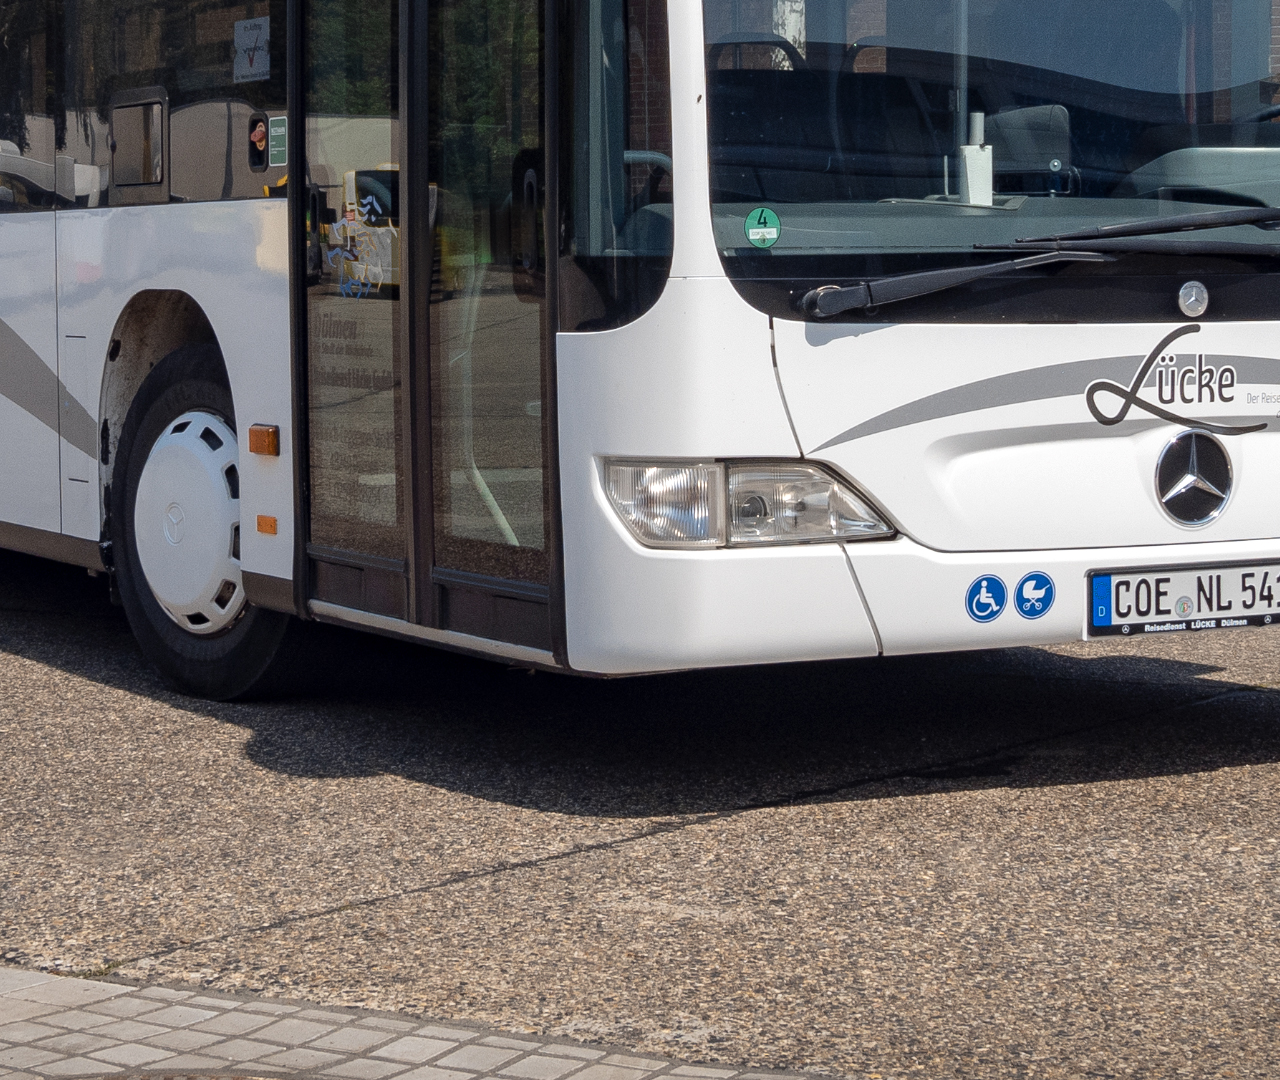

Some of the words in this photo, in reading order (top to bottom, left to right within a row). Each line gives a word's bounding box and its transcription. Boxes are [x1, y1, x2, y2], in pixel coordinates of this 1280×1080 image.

[757, 209, 768, 227] 4
[1086, 324, 1268, 435] Lücke
[1247, 393, 1259, 404] Der
[1115, 577, 1171, 618] COE
[1197, 574, 1232, 613] NL
[1098, 605, 1106, 617] D
[1145, 623, 1186, 632] Reisedienst
[1191, 620, 1216, 629] LÜCKE
[1221, 619, 1248, 627] Dülmen
